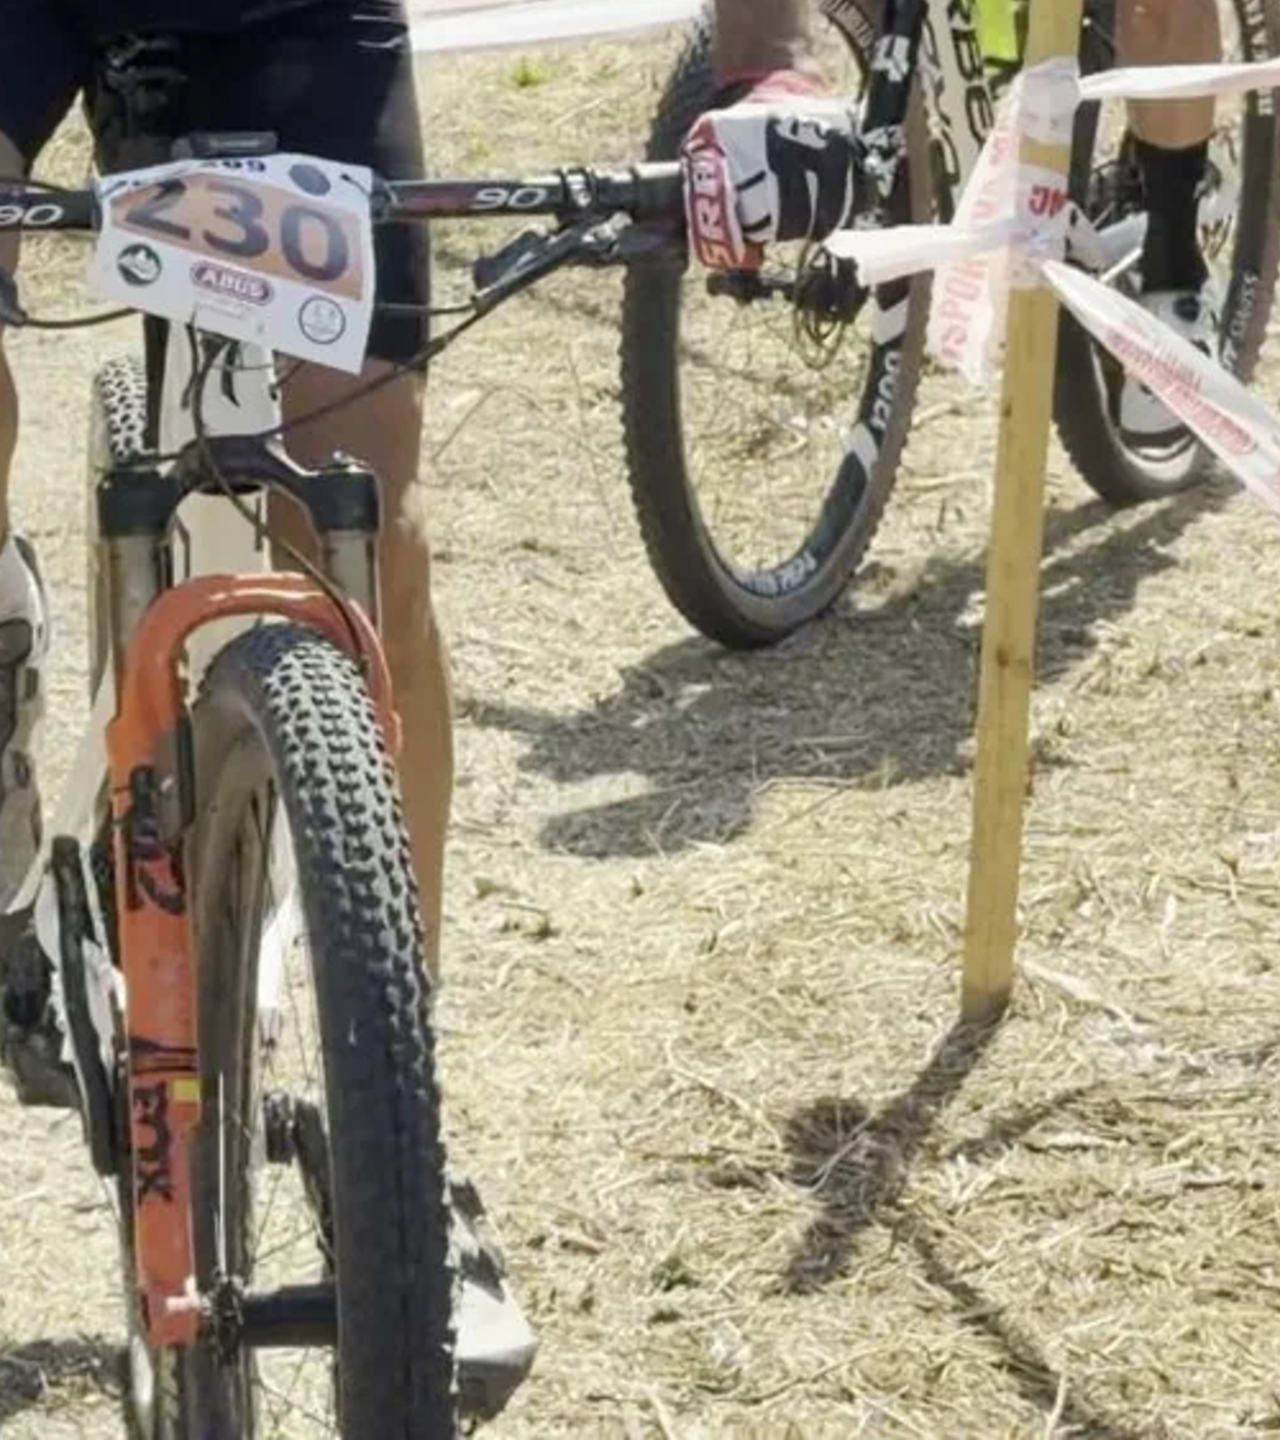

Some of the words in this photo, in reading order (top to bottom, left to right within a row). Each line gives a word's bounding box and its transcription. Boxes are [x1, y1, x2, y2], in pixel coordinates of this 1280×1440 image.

[124, 176, 350, 282] 230
[201, 264, 269, 297] ABUS
[133, 1080, 174, 1205] FOX
